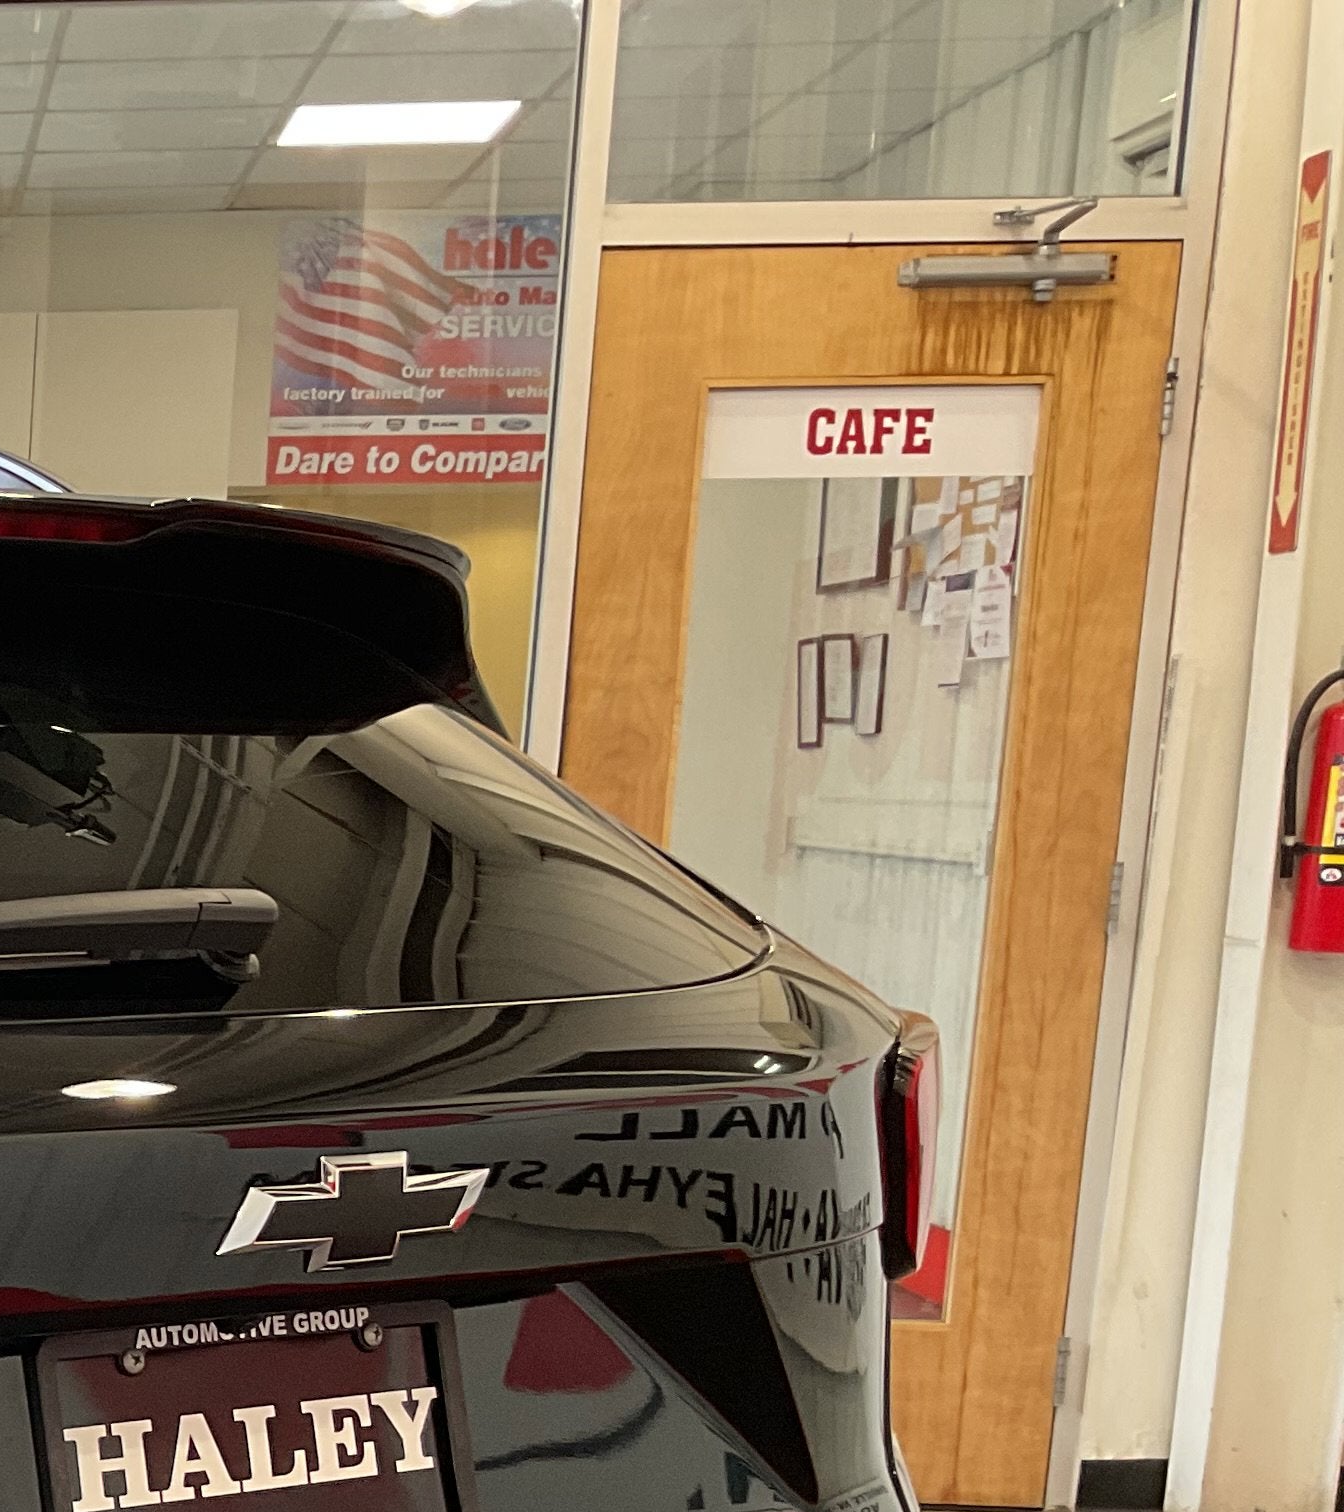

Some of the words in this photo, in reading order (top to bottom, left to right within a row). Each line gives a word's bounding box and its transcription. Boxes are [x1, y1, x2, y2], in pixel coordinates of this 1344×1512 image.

[401, 365, 434, 379] Our
[439, 364, 543, 379] technicians
[283, 387, 346, 403] factory
[351, 386, 414, 401] trained
[415, 385, 446, 404] for
[805, 406, 936, 456] CAFE
[275, 445, 355, 475] Dare
[366, 445, 400, 474] to
[135, 1314, 288, 1350] AUTOMVE
[292, 1306, 370, 1334] GROUP
